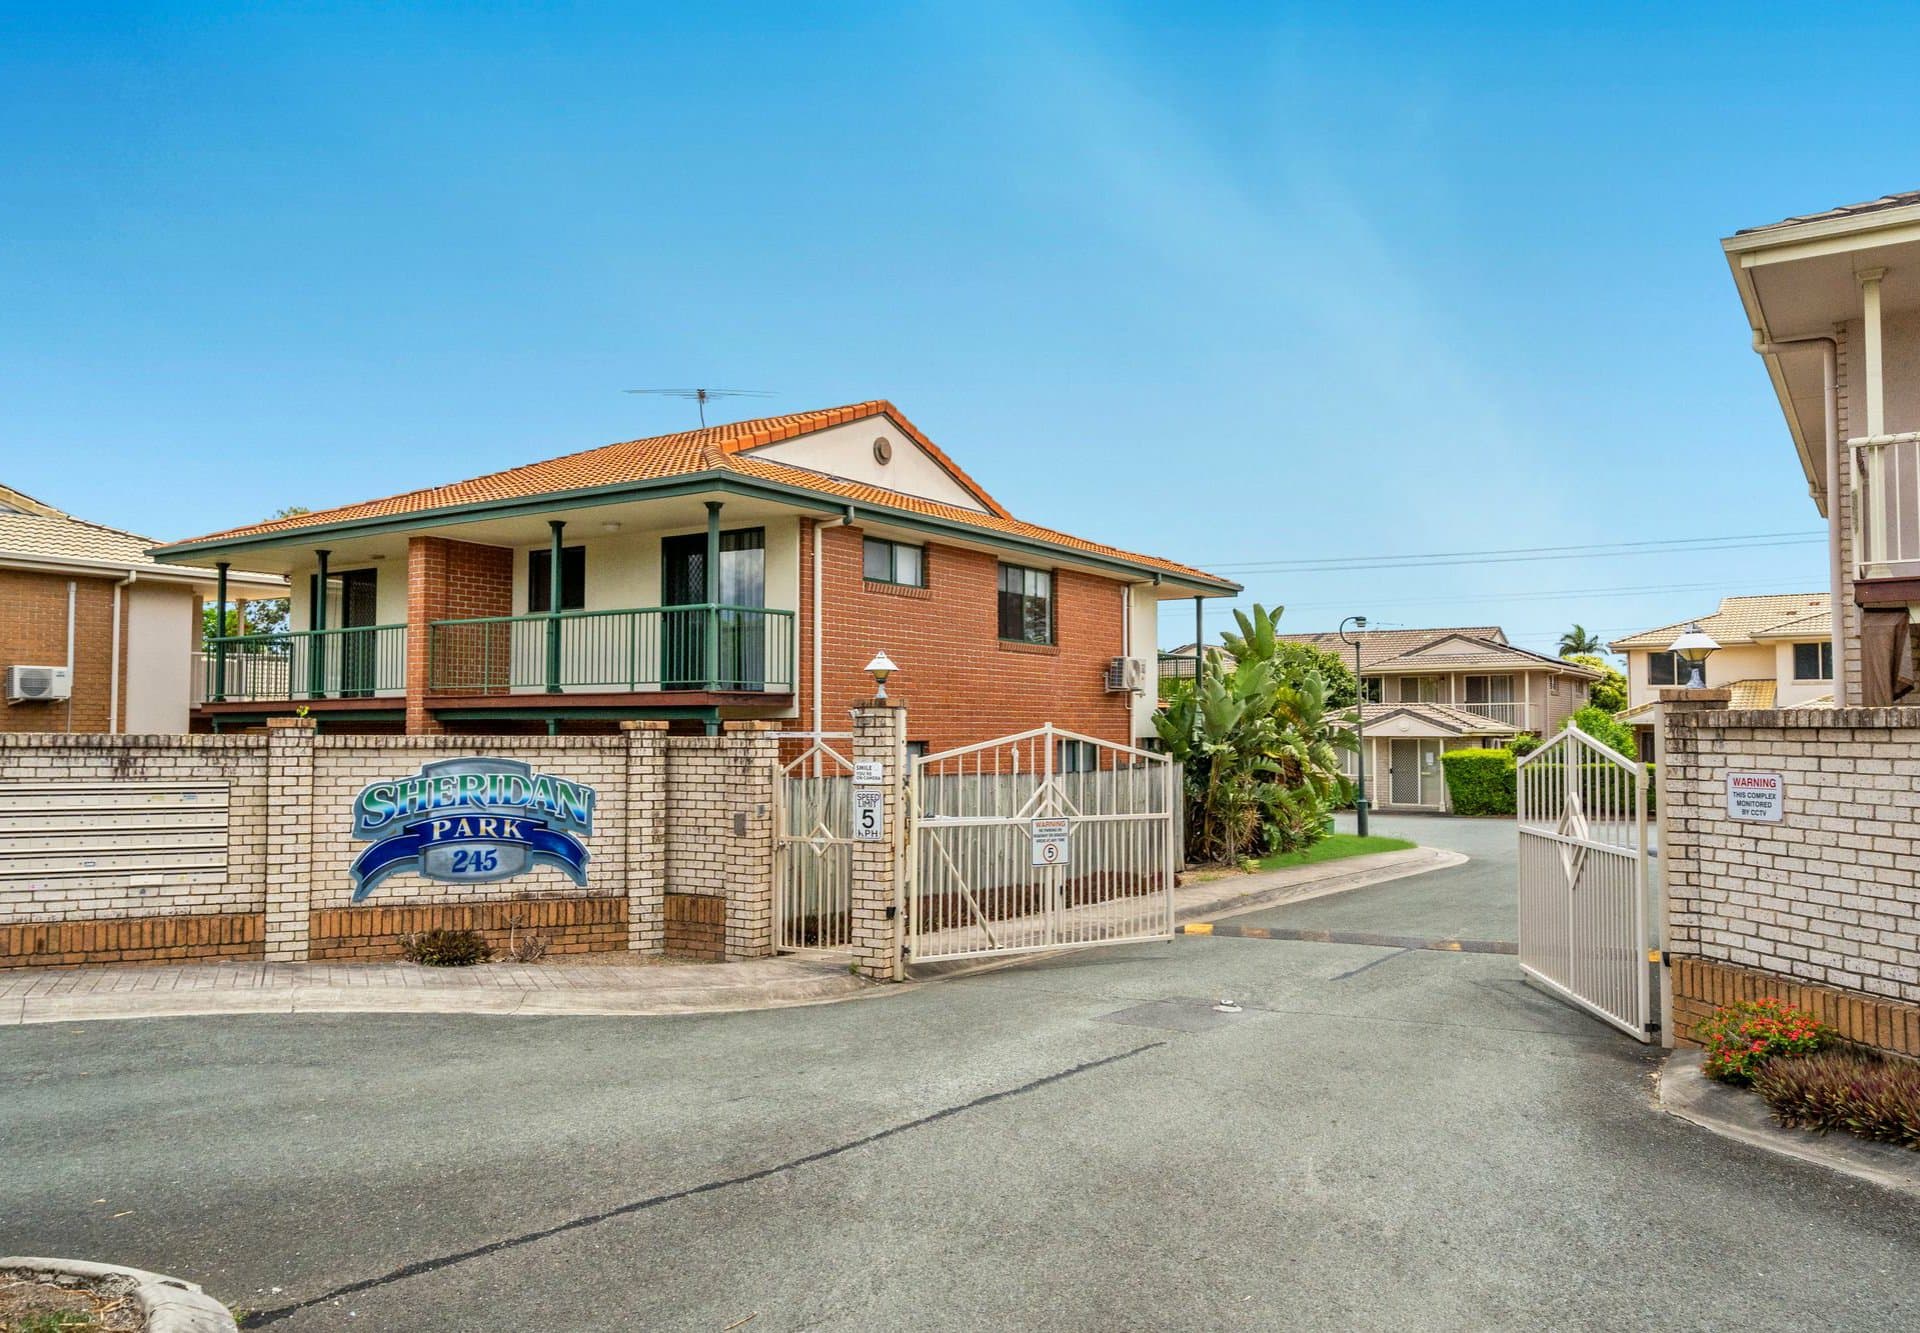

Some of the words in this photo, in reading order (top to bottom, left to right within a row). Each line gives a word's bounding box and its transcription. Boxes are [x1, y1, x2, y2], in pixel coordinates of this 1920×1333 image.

[1733, 777, 1776, 788] WARNING
[361, 773, 590, 829] SHERIDAN
[857, 793, 880, 801] SPEED
[1747, 792, 1776, 800] COMPLEX
[1737, 800, 1772, 808] MONITORED
[862, 809, 875, 829] 5
[431, 818, 524, 840] PARK
[1047, 847, 1054, 858] 5
[452, 848, 498, 873] 245
